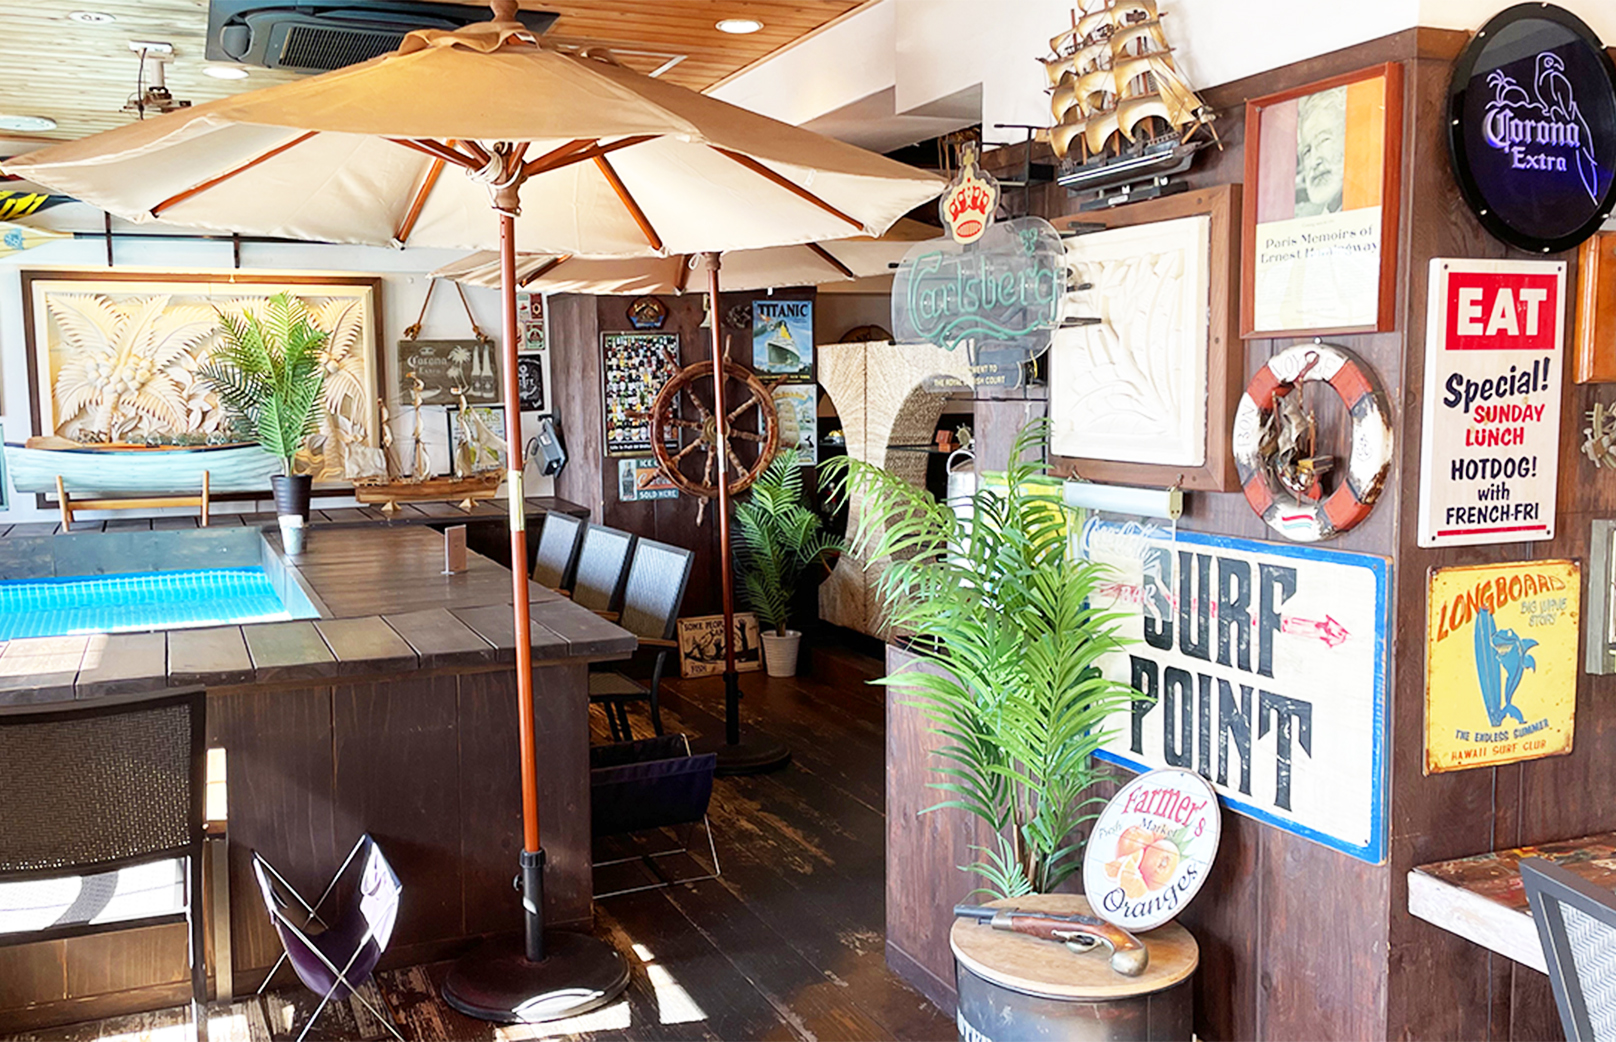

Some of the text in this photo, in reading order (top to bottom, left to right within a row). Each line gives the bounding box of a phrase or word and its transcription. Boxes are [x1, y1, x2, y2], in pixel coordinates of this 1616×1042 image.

[1482, 108, 1581, 153] Corona
[1511, 146, 1567, 171] Extra
[1265, 224, 1373, 249] Paris Memoirs of
[1261, 242, 1378, 264] Ernest Hingway
[907, 252, 1064, 340] Carlsberg
[757, 303, 809, 317] TITANIC
[1457, 287, 1547, 336] EAT
[407, 355, 447, 370] Corona
[1443, 357, 1551, 414] Special!
[1237, 353, 1336, 447] BON VOYGE
[1473, 403, 1546, 425] SUNDAY
[1465, 427, 1525, 447] LUNCH
[1450, 456, 1537, 481] HOTDOG!
[1477, 482, 1510, 502] with
[1445, 503, 1539, 525] FRENCH-FRI
[1121, 584, 1156, 604] BAR
[1144, 546, 1297, 679] SURF
[1437, 573, 1566, 642] LONGBOARD
[705, 619, 725, 629] PEOP
[1130, 654, 1313, 812] POINT
[1455, 718, 1549, 743] THE ENDLESS SUMMER
[1451, 739, 1546, 761] HAWAII SURF CLUB
[1121, 785, 1208, 837] Farmer's
[1140, 818, 1178, 837] Market
[1103, 864, 1198, 918] Oranges
